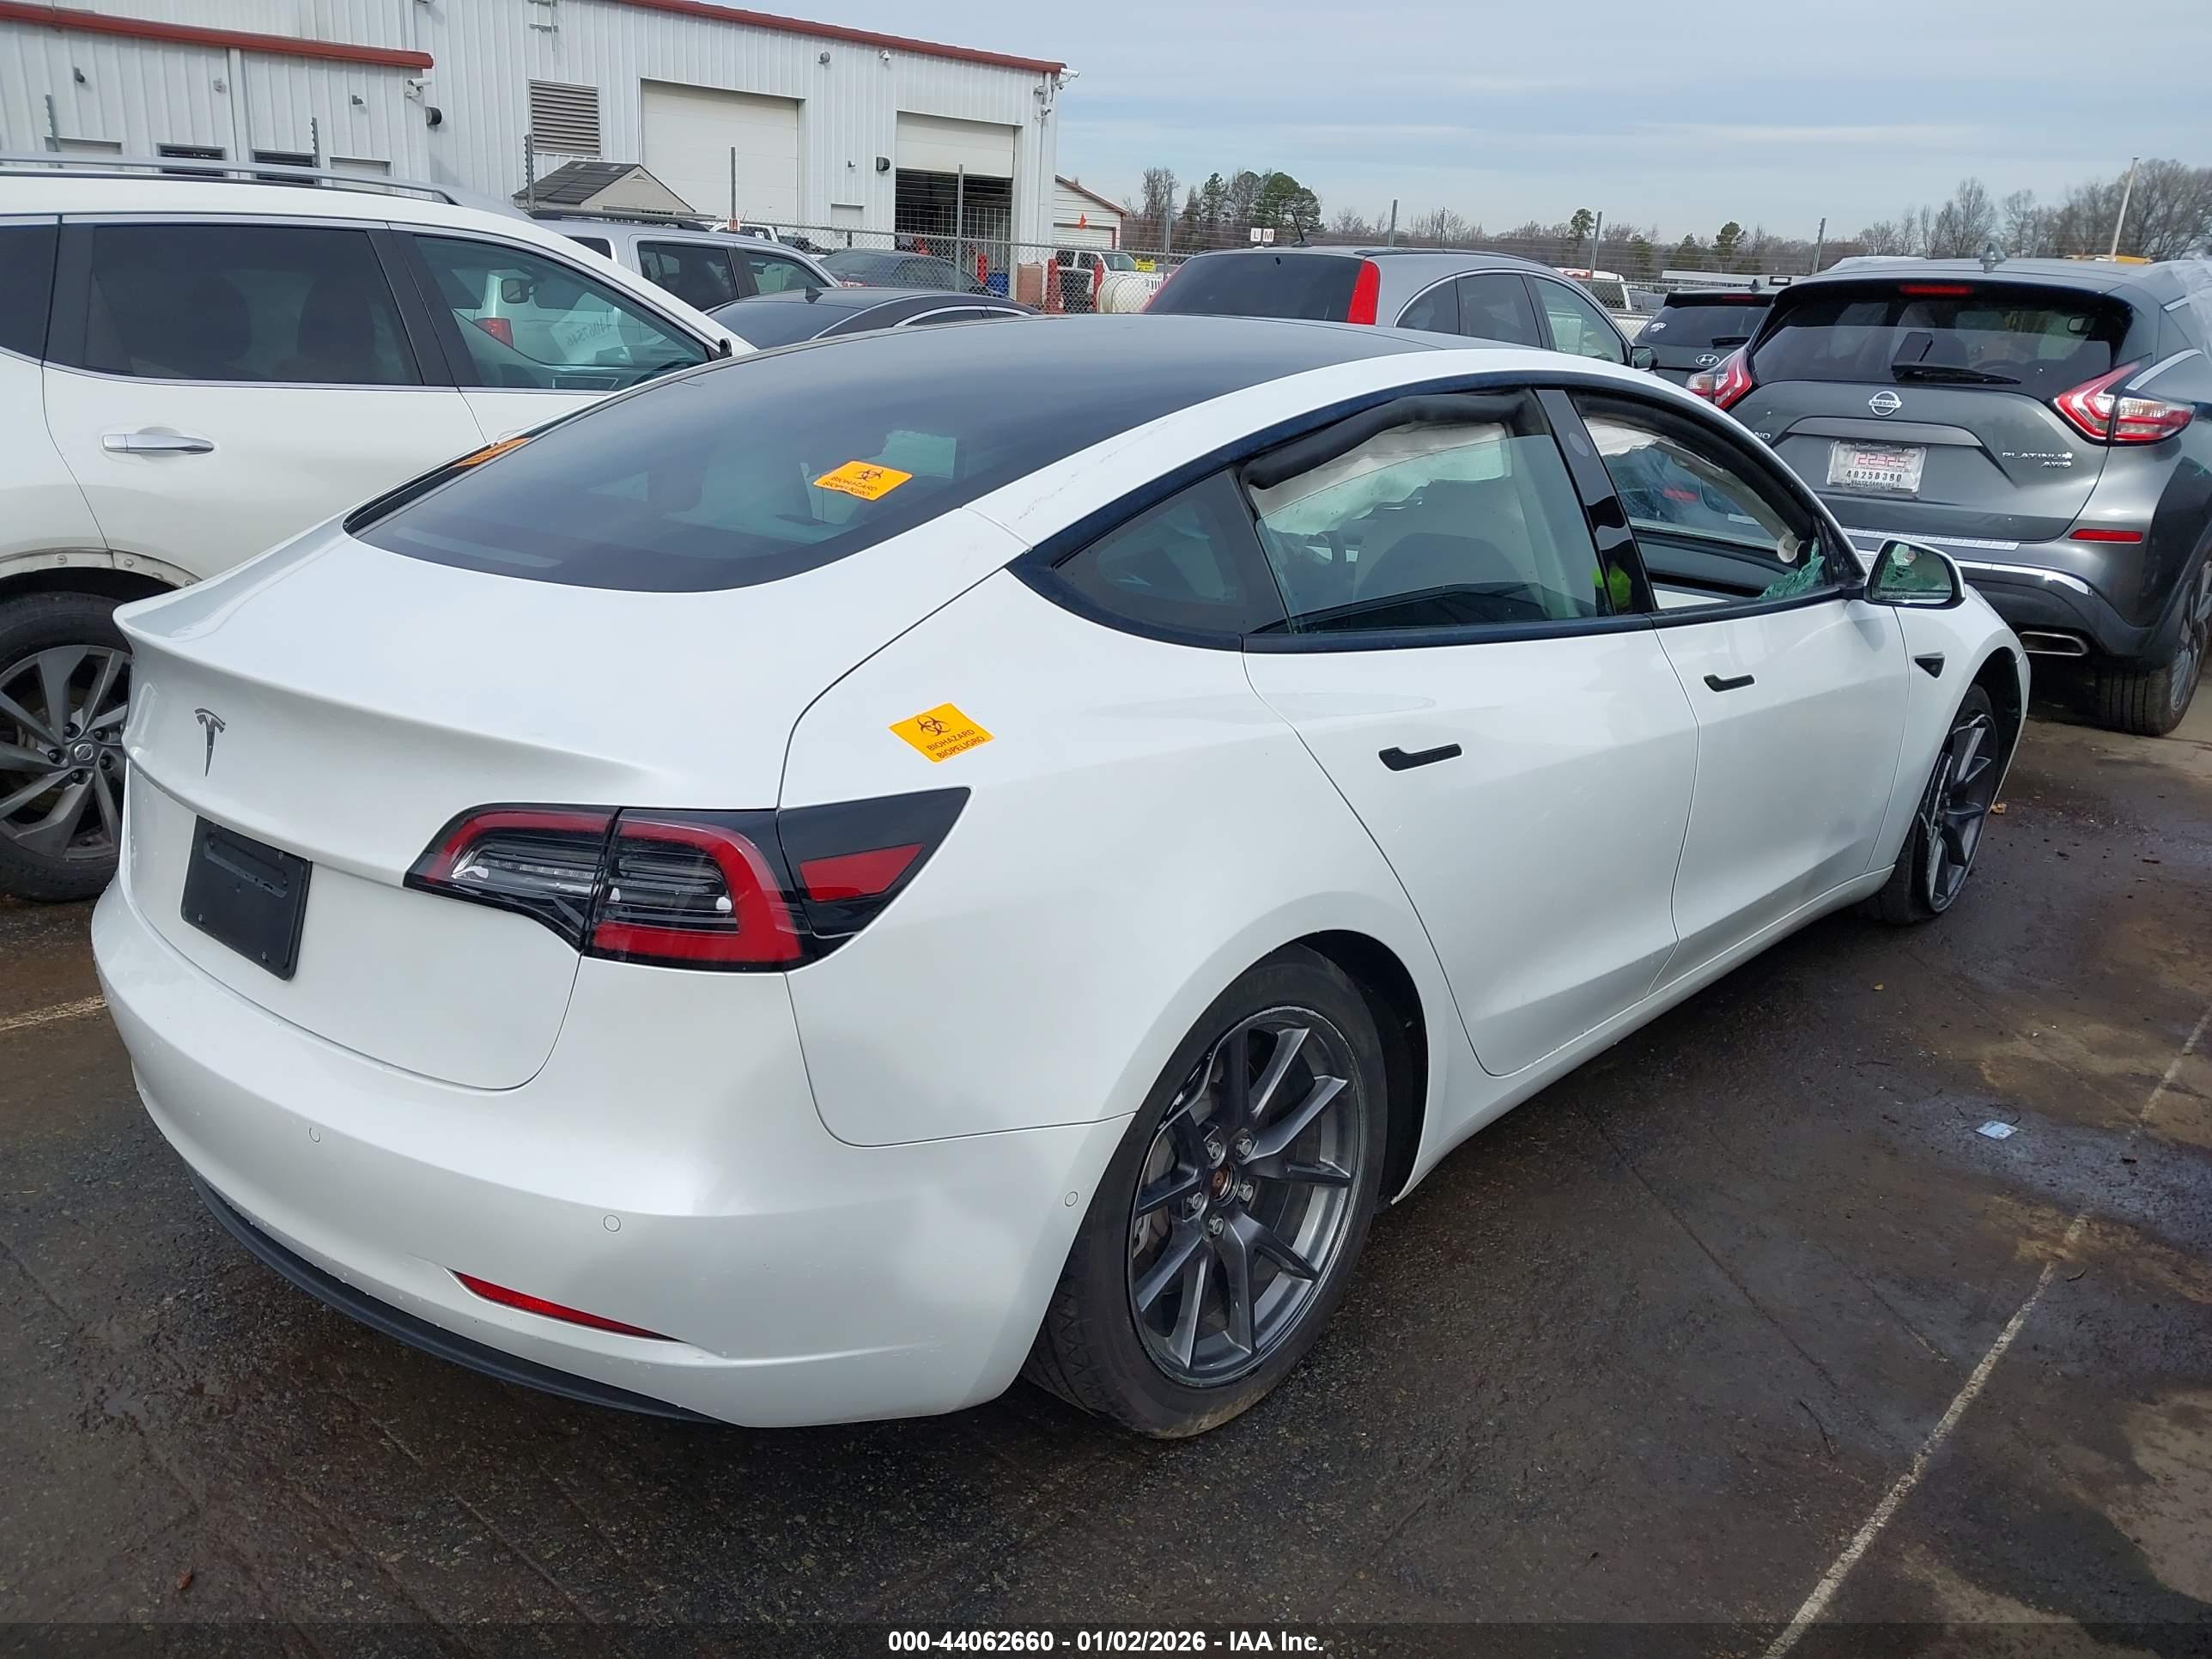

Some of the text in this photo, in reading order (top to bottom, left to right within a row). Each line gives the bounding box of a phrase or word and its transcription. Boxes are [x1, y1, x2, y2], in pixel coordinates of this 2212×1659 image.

[1254, 230, 1259, 240] L
[1264, 231, 1273, 240] M
[927, 729, 975, 751] BIOHAZARD
[936, 736, 986, 759] BIOPELIGRO
